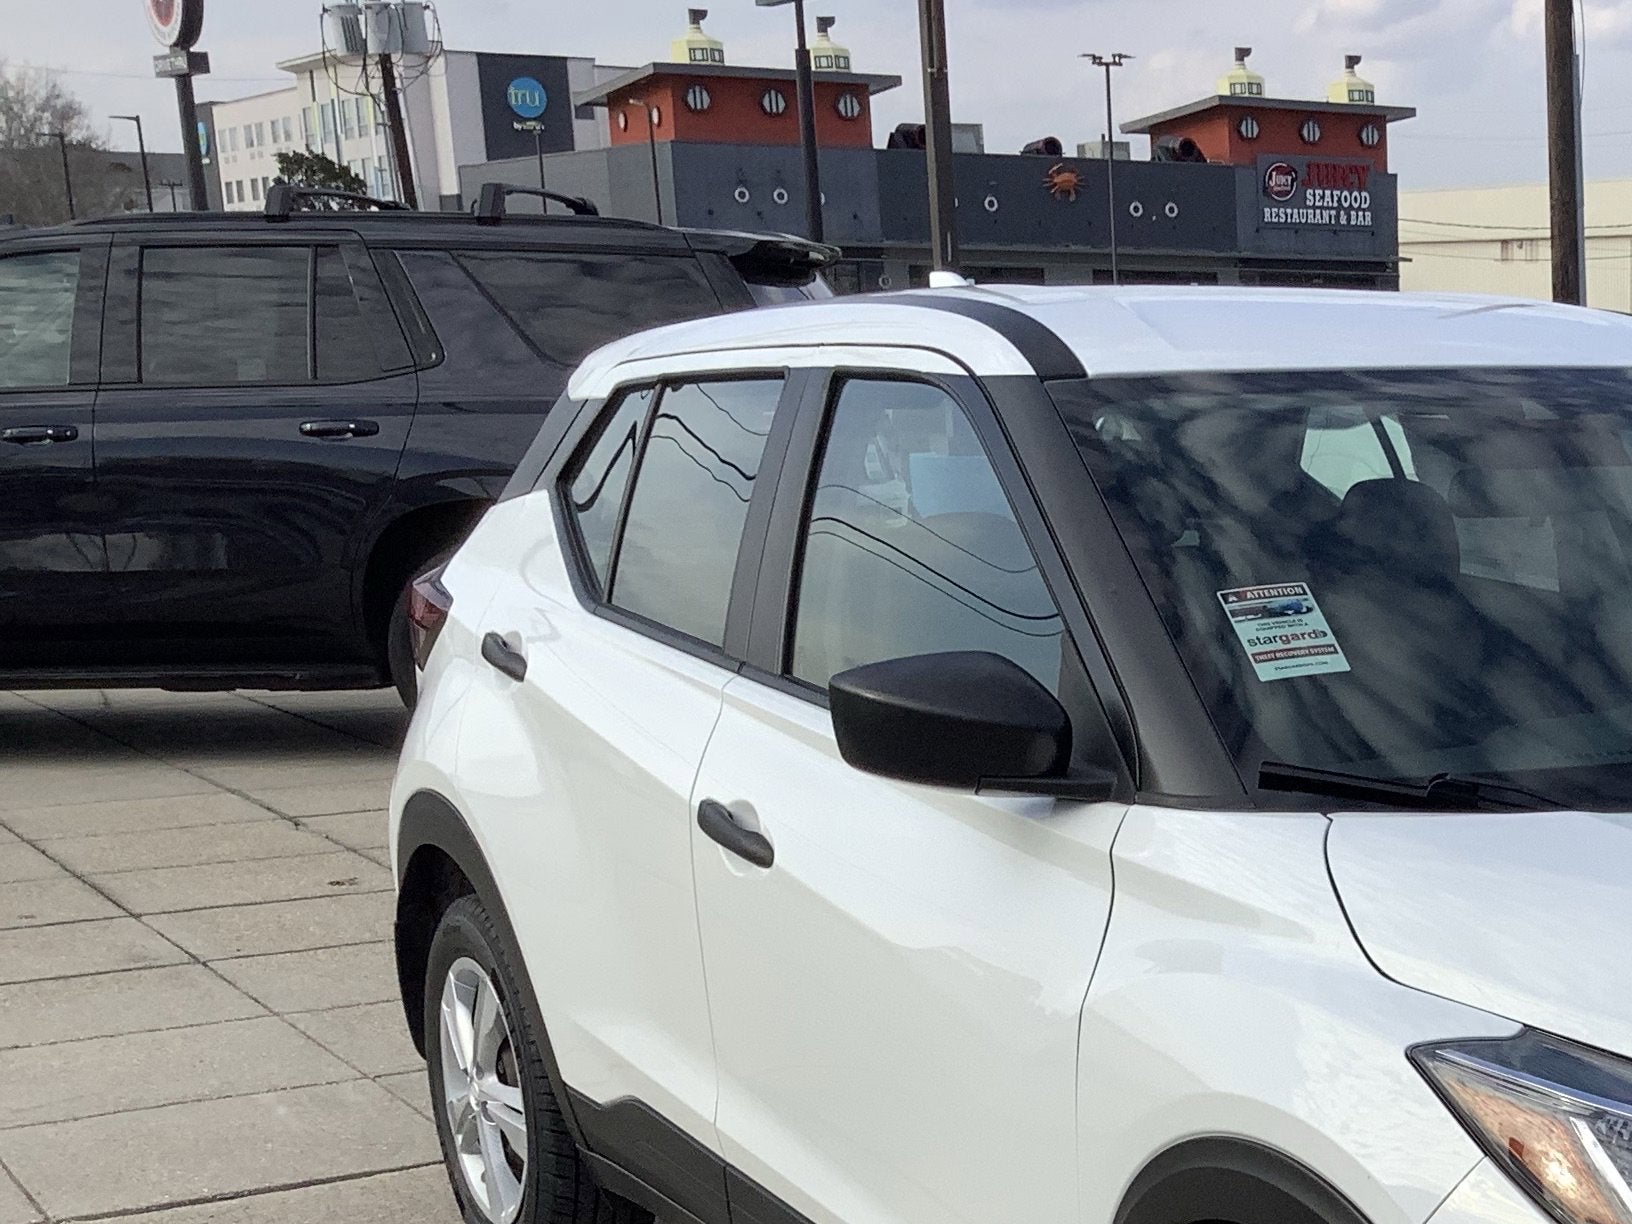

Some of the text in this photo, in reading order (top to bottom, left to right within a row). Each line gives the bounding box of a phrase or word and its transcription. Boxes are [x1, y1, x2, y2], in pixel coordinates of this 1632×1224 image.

[508, 84, 540, 107] tru
[1306, 189, 1370, 209] SEAFOOD
[1263, 208, 1372, 226] RESTAURANT & BAR
[1246, 586, 1304, 600] ATTENTION
[1275, 649, 1309, 660] RECOVERY
